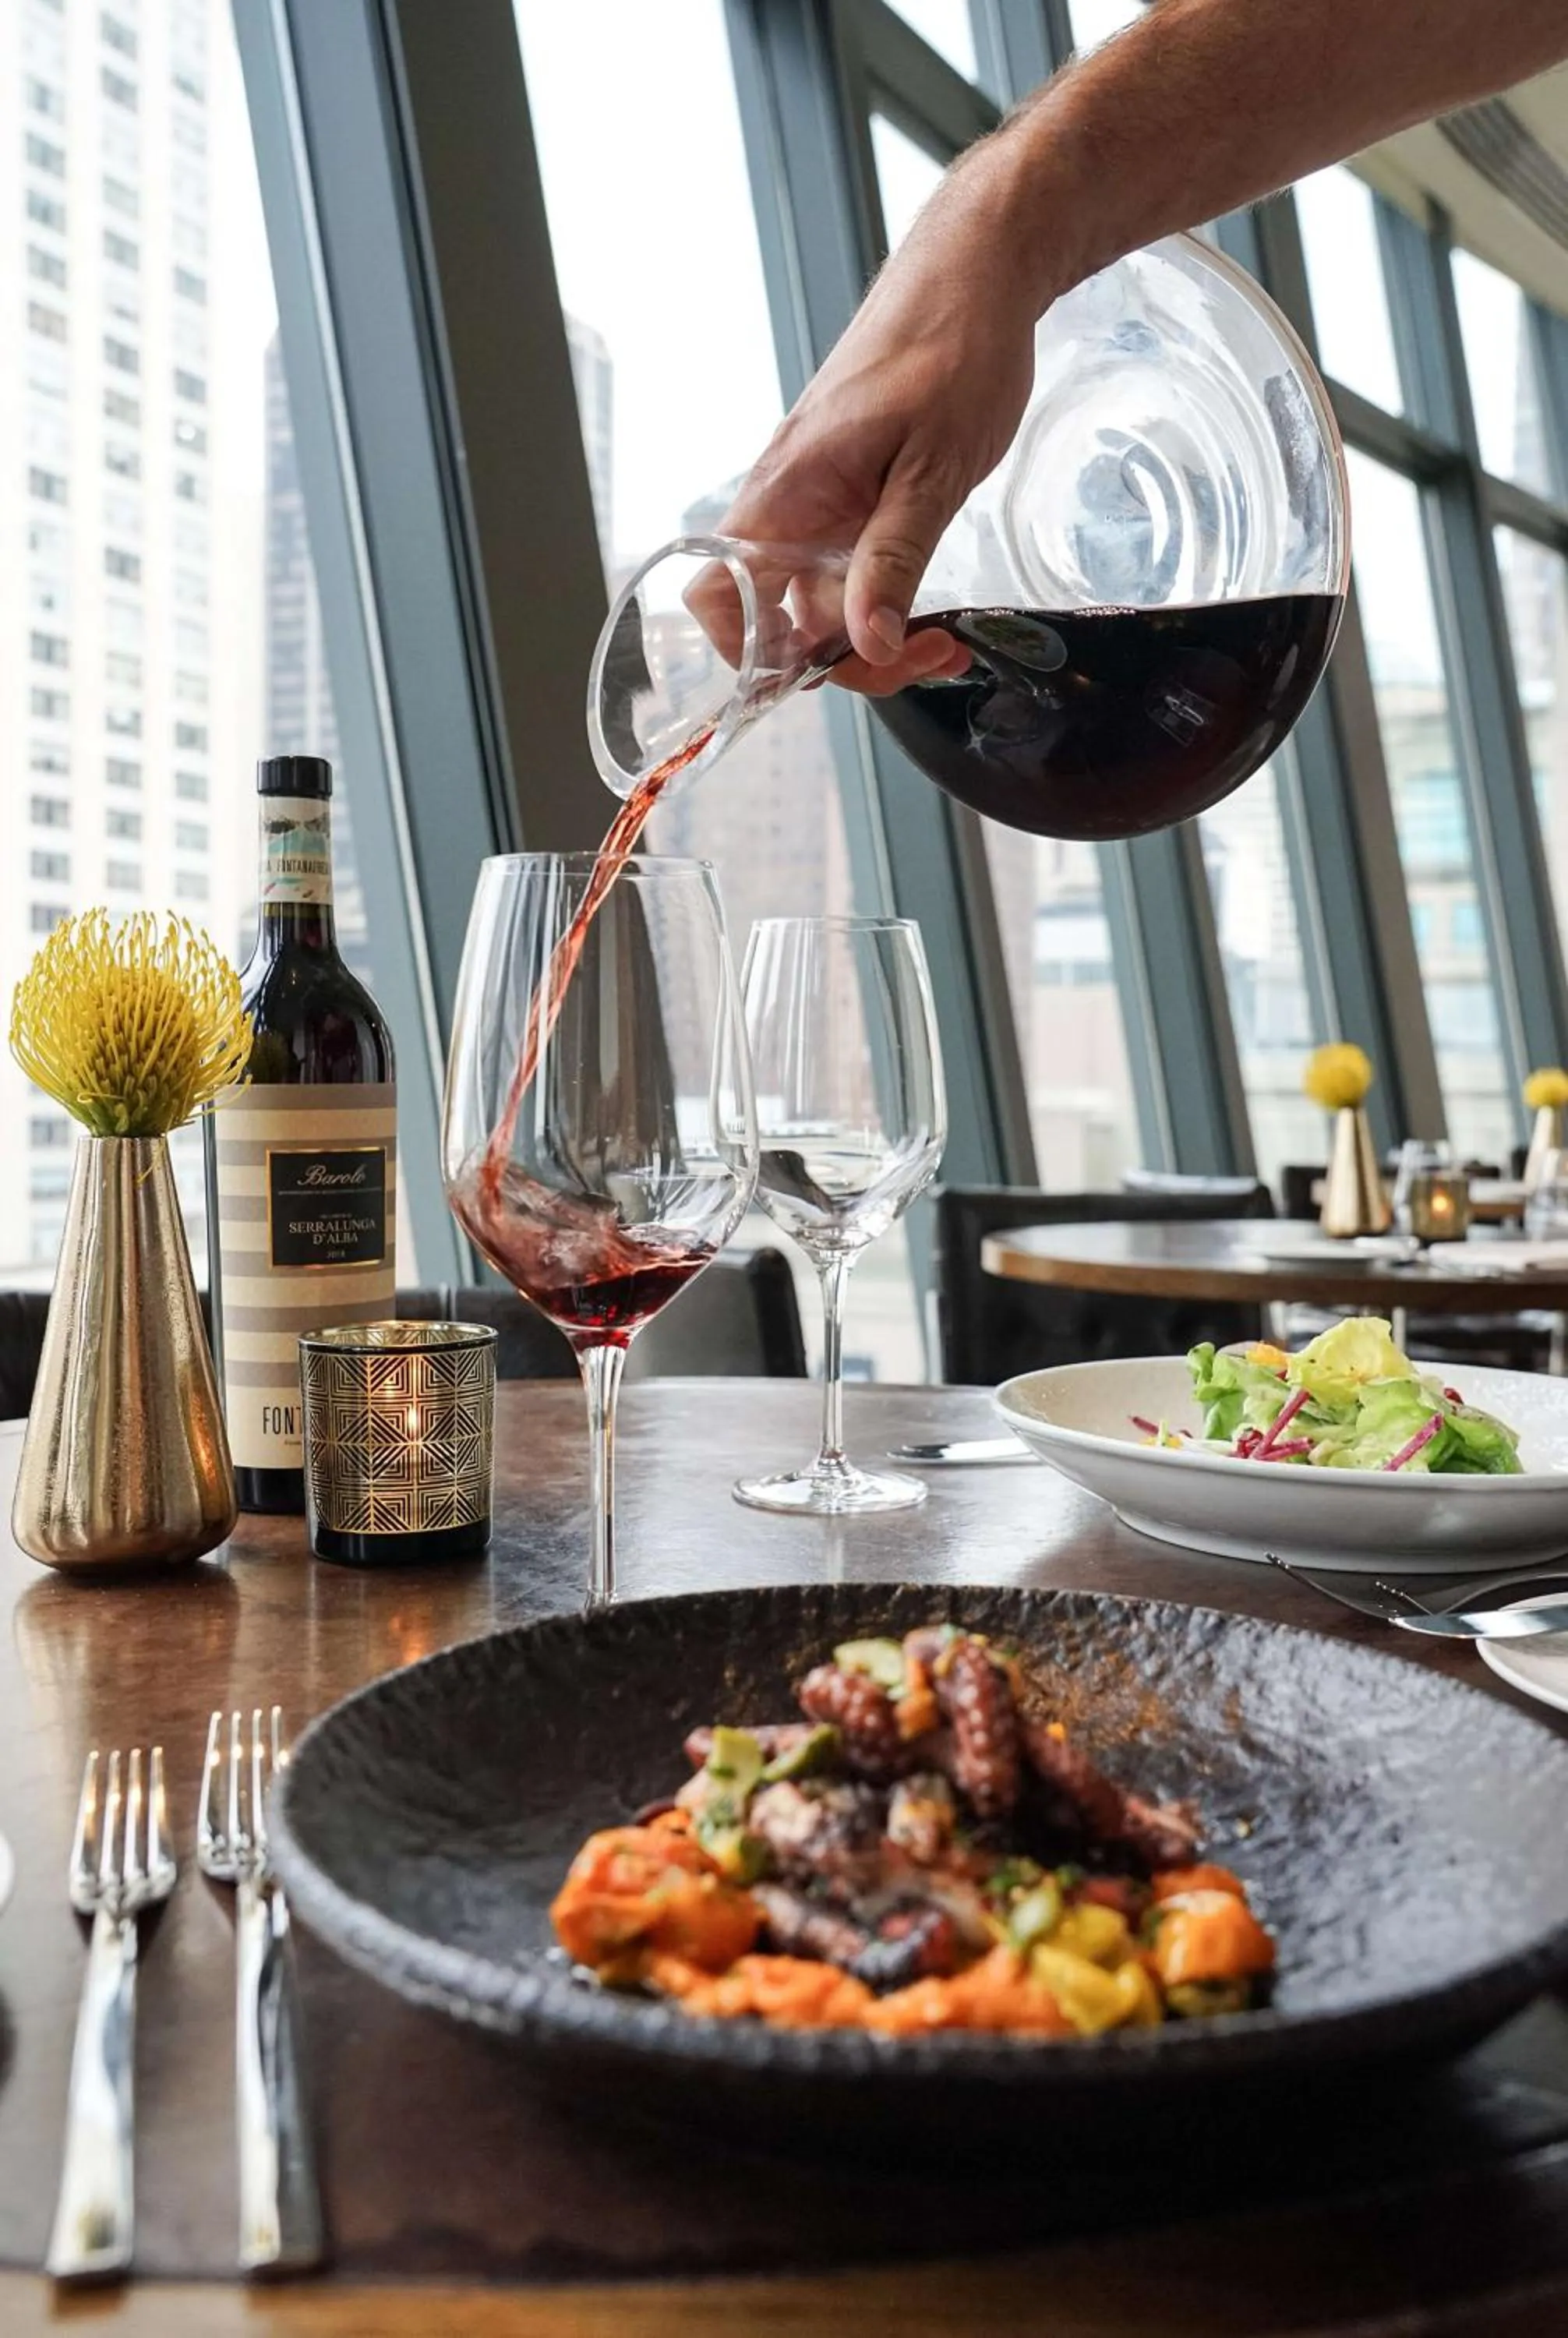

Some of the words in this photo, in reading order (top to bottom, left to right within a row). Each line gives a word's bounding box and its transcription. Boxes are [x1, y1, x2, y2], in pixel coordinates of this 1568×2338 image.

[297, 1164, 367, 1185] Barolo
[288, 1218, 376, 1234] SERRALUNGA
[313, 1232, 358, 1245] D'ALBA
